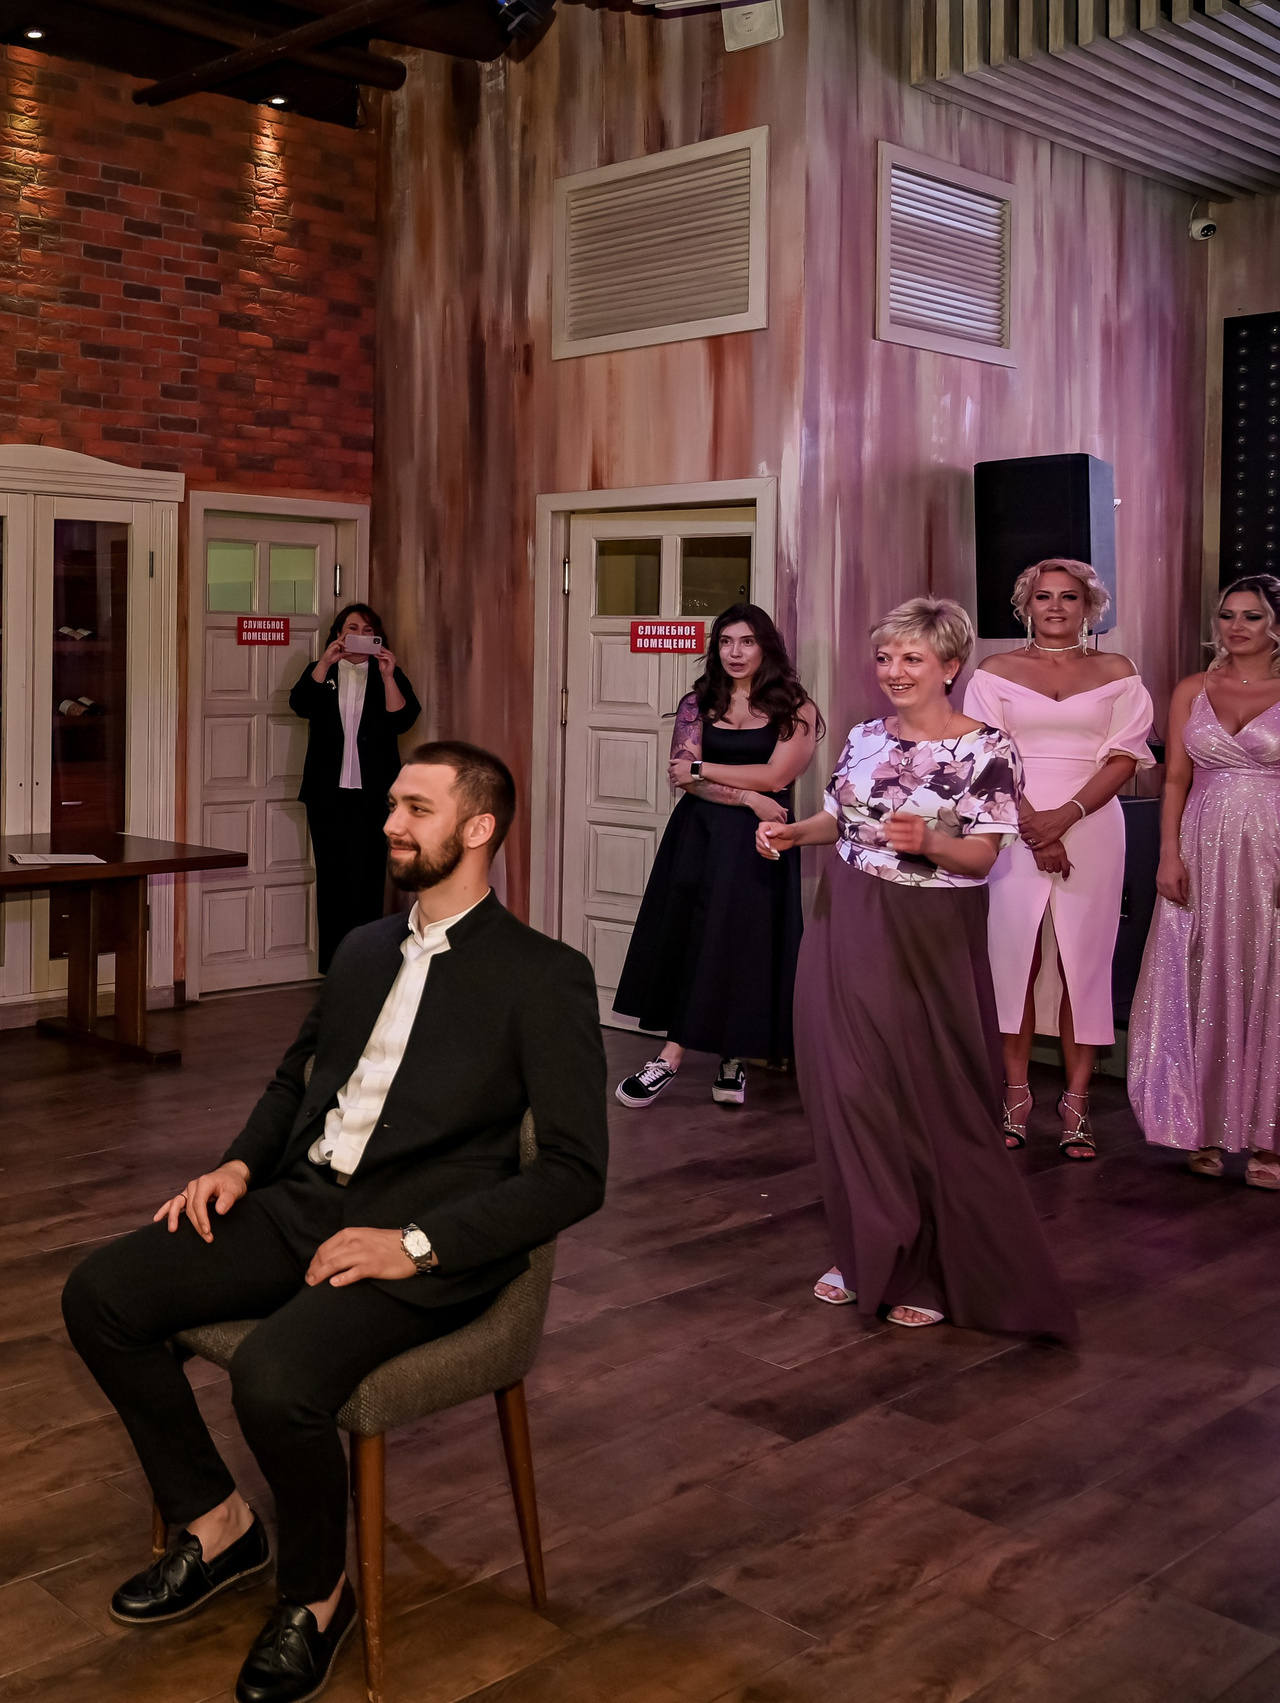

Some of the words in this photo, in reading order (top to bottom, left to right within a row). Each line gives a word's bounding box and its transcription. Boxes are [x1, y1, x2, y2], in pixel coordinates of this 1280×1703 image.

[243, 620, 284, 629] СЛУЖЕБНОЕ
[638, 625, 696, 636] СЛУЖЕБНОЕ
[242, 632, 285, 641] ПОМЕЩЕНИЕ
[636, 638, 697, 649] ПОМЕЩЕНИЕ
